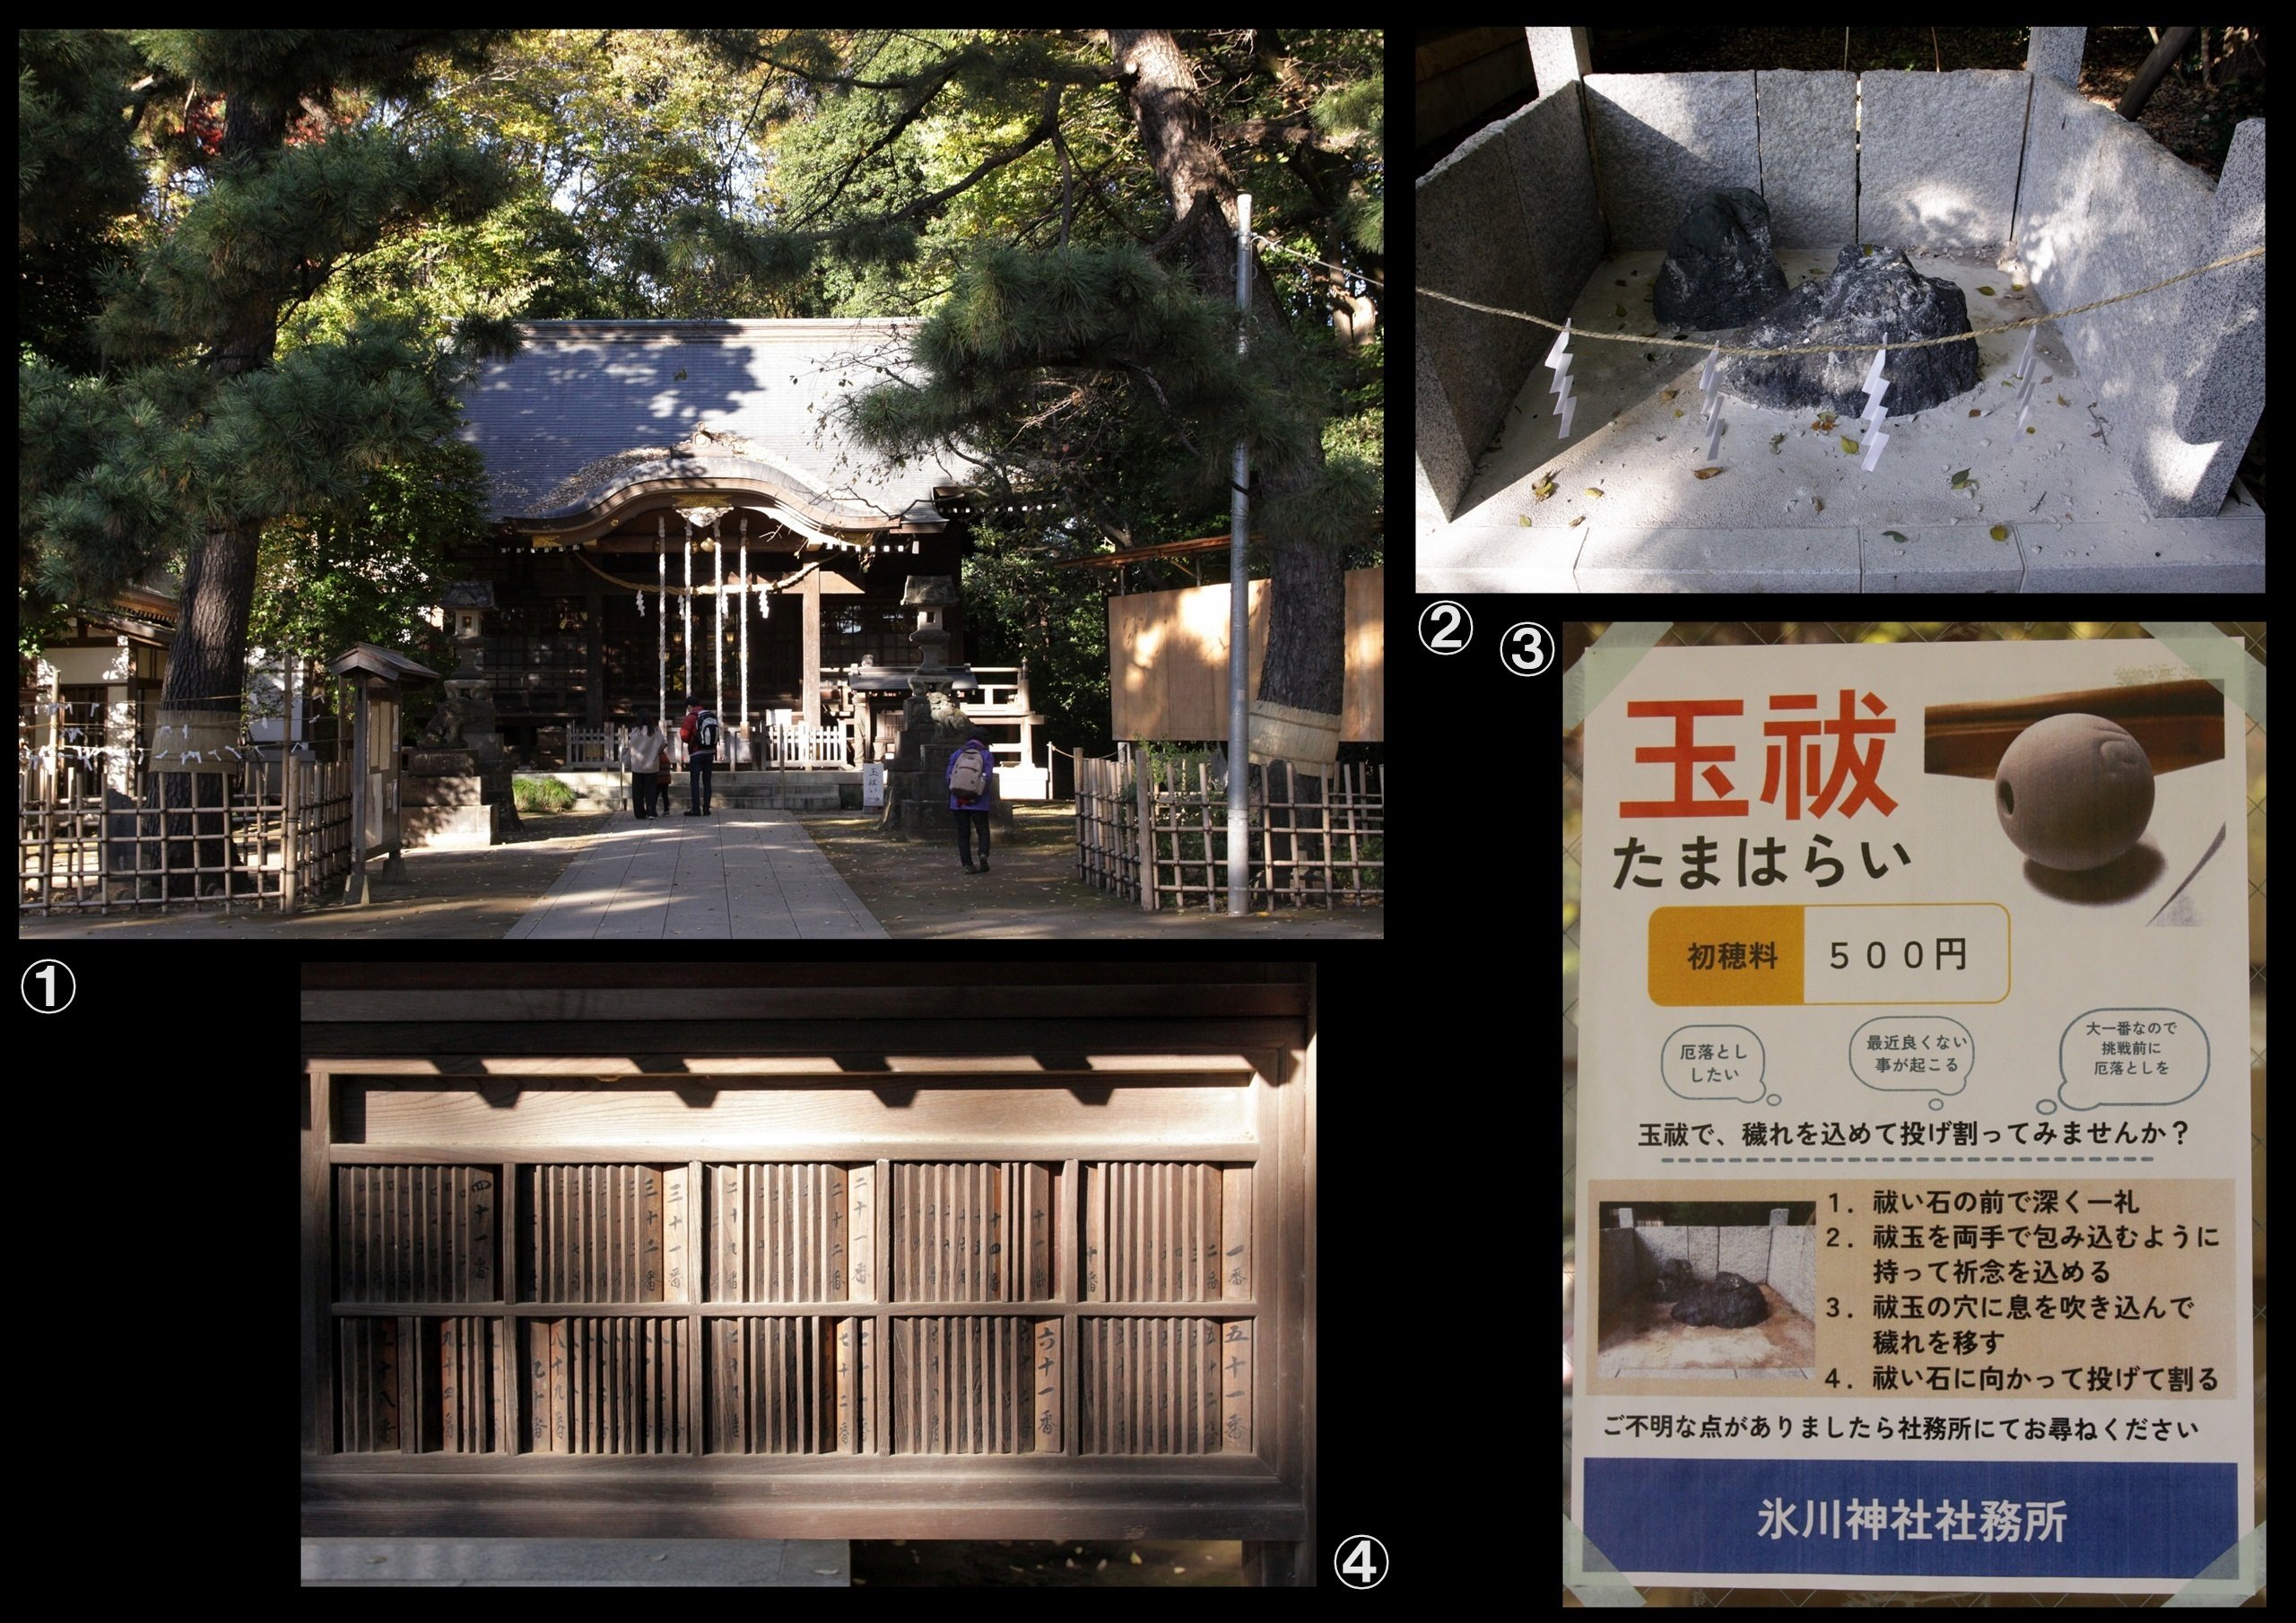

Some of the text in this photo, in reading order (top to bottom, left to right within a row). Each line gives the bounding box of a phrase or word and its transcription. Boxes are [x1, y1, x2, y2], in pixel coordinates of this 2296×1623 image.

[1620, 690, 1899, 820] 玉祓
[1613, 834, 1911, 890] たまはらい
[1687, 942, 1778, 971] 初穂料
[2086, 1020, 2178, 1036] 大一番なので
[1680, 1044, 1748, 1061] 厄落とし
[1866, 1034, 1968, 1051] 最近良くない
[2101, 1041, 2161, 1055] 挑戦前に
[1692, 1067, 1740, 1083] したい
[1874, 1056, 1959, 1073] 事が起こる
[2094, 1061, 2169, 1076] 厄落としを
[1873, 1190, 2140, 1215] 祓い石の前で深く一礼
[1873, 1224, 2220, 1249] 祓玉を両手で包み込むように
[1873, 1259, 2110, 1284] 持って祈念を込める
[1873, 1294, 2195, 1320] 祓玉の穴に息を吹き込んで
[1873, 1330, 2005, 1355] 穢れを移す
[1873, 1366, 2218, 1392] 祓い石に向かって投げて割る
[1604, 1414, 2199, 1442] ご不明な点がありましたら社務所にてお尋ねください
[1757, 1497, 2067, 1543] 氷川神社社務所
